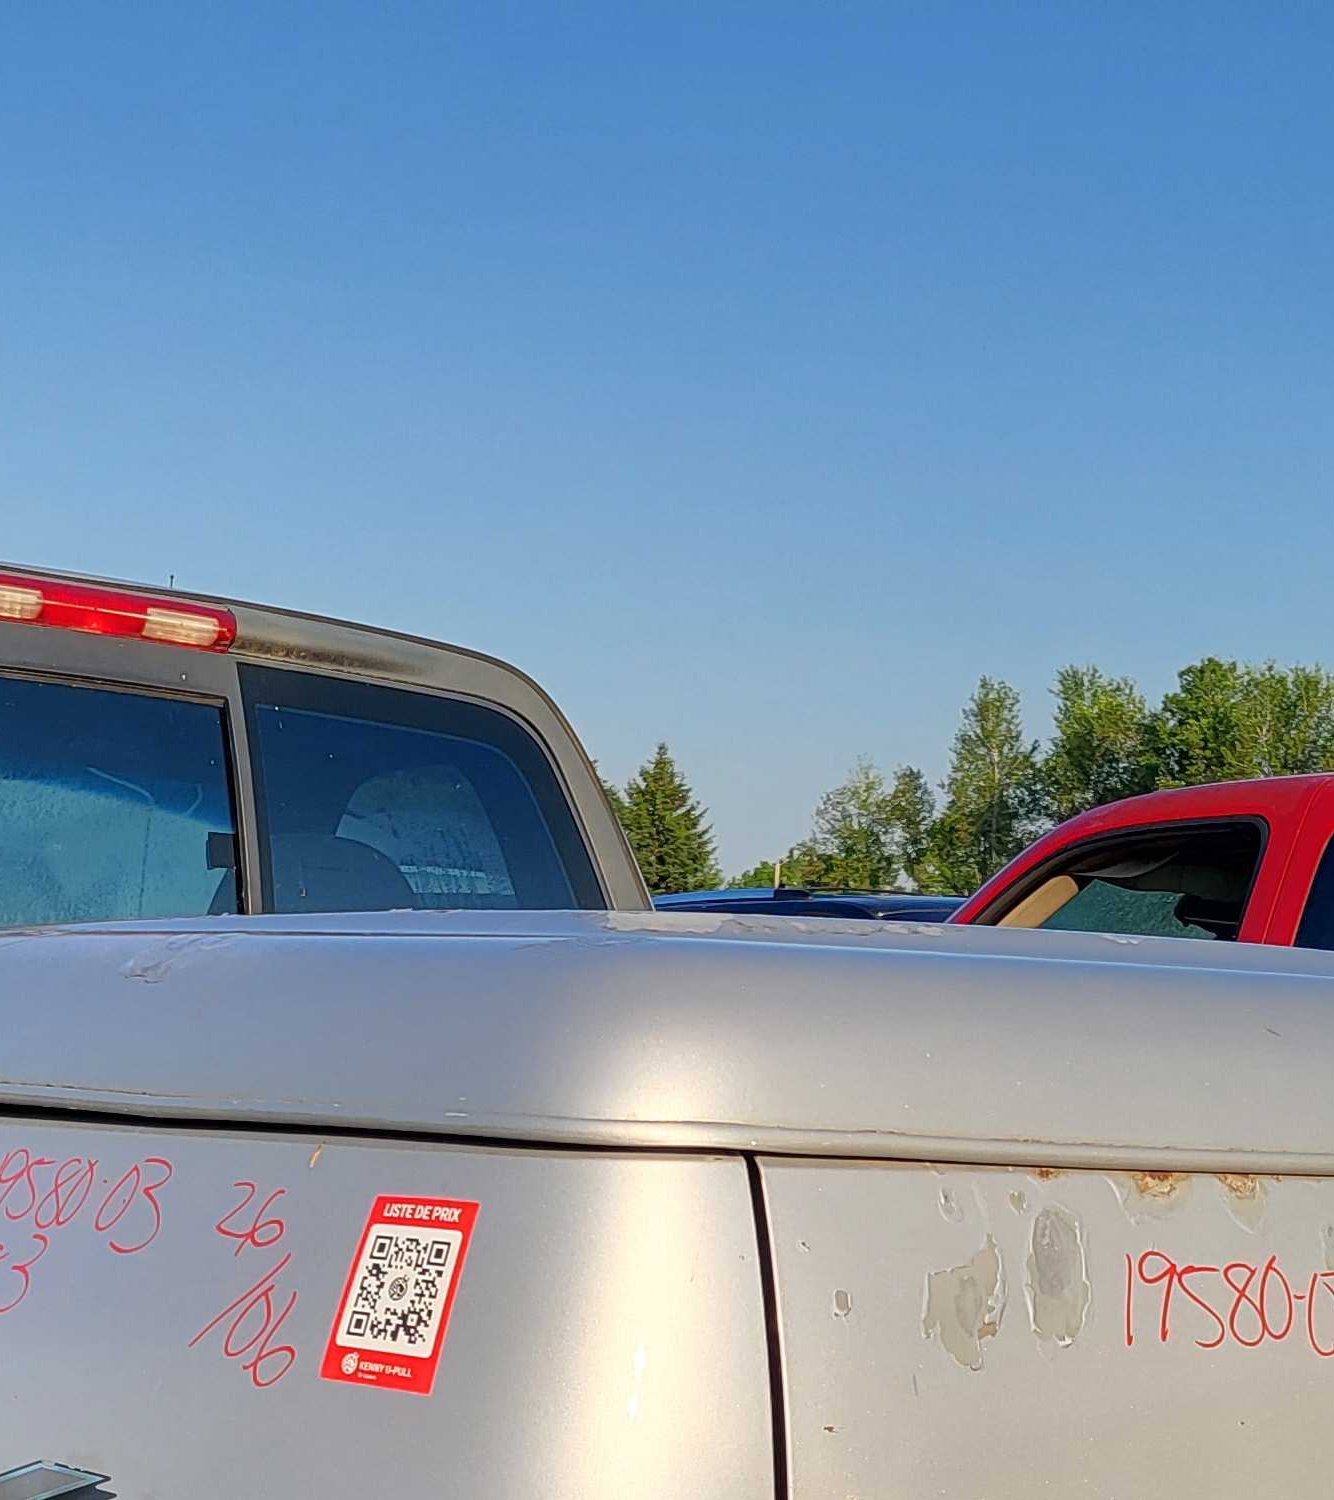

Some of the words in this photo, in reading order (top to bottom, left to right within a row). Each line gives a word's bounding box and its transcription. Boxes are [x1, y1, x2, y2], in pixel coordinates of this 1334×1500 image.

[382, 1202, 415, 1218] LISTE
[414, 1204, 433, 1220] DE
[431, 1206, 463, 1222] PRIX
